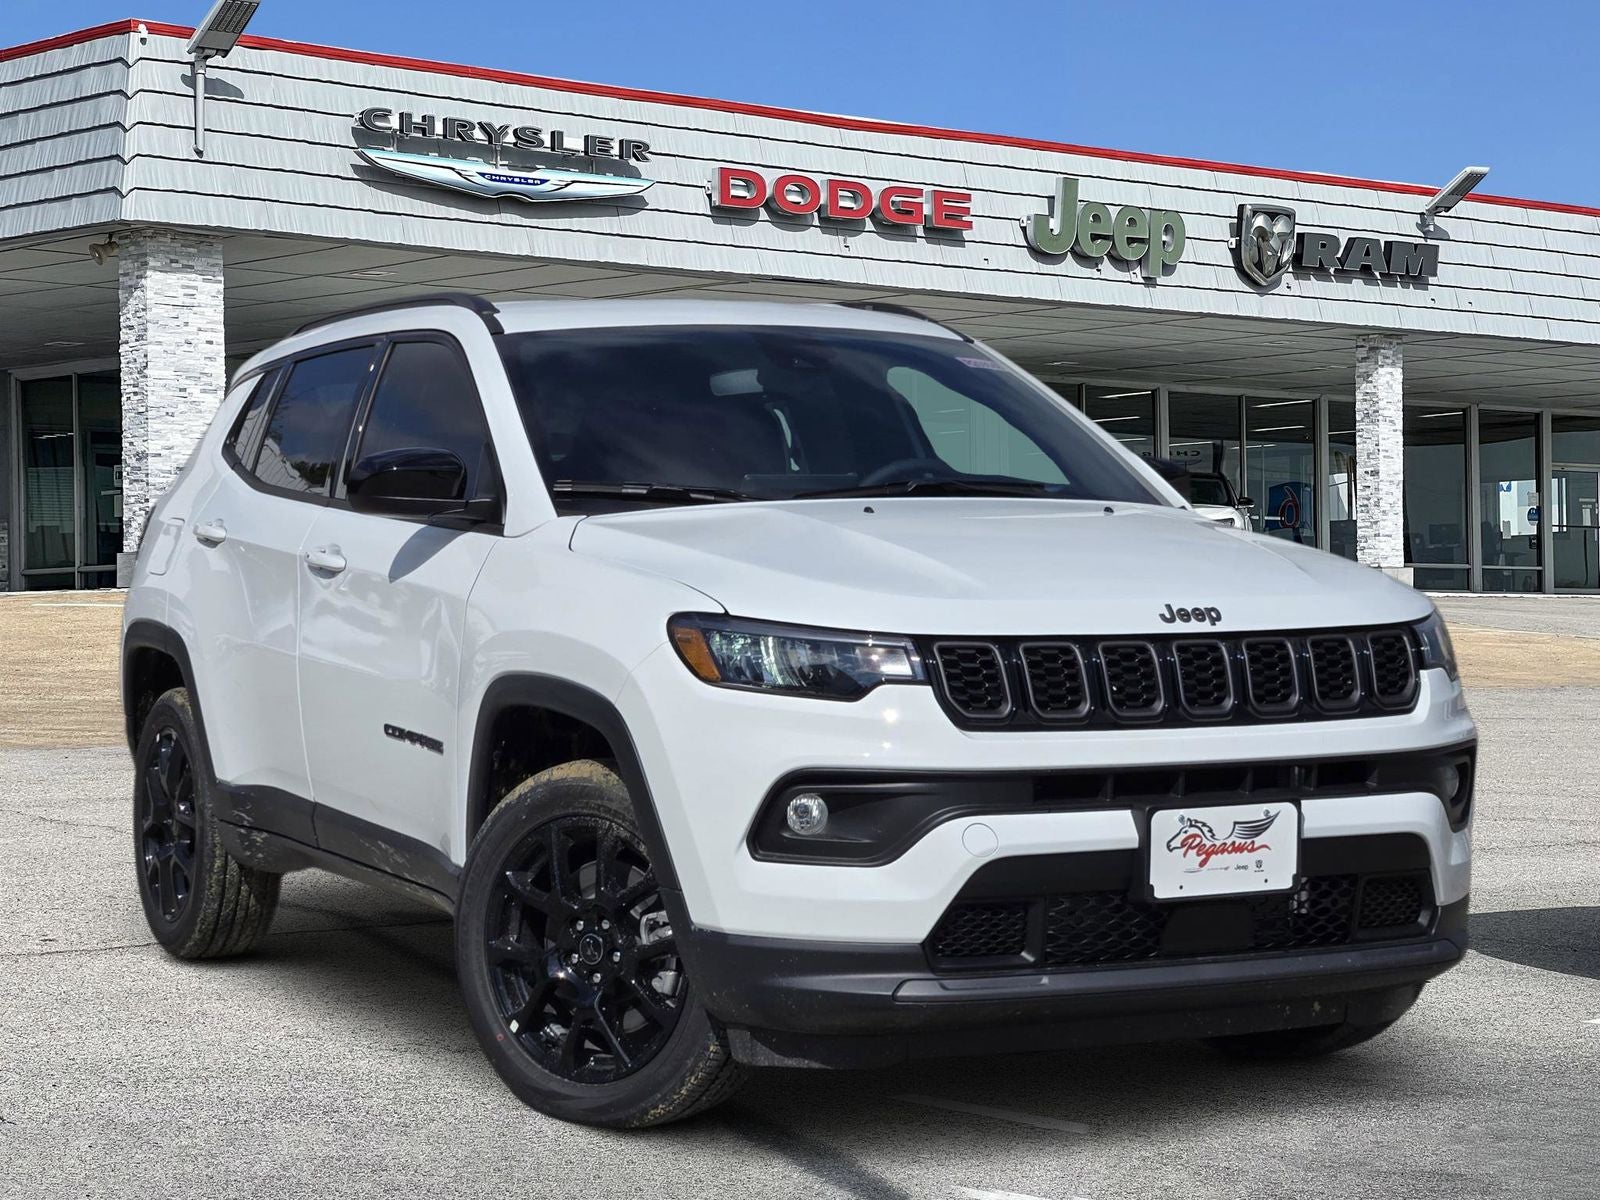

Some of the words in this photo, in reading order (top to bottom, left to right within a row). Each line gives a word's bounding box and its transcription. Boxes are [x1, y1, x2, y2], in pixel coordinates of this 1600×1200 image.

[359, 107, 652, 162] CHRYSLER
[484, 174, 541, 185] CHRYSLER
[712, 166, 973, 231] DODGE
[1026, 176, 1186, 279] Jeep
[1296, 231, 1440, 278] RAM
[1159, 603, 1222, 627] Jeep
[1180, 833, 1271, 868] Pegasus
